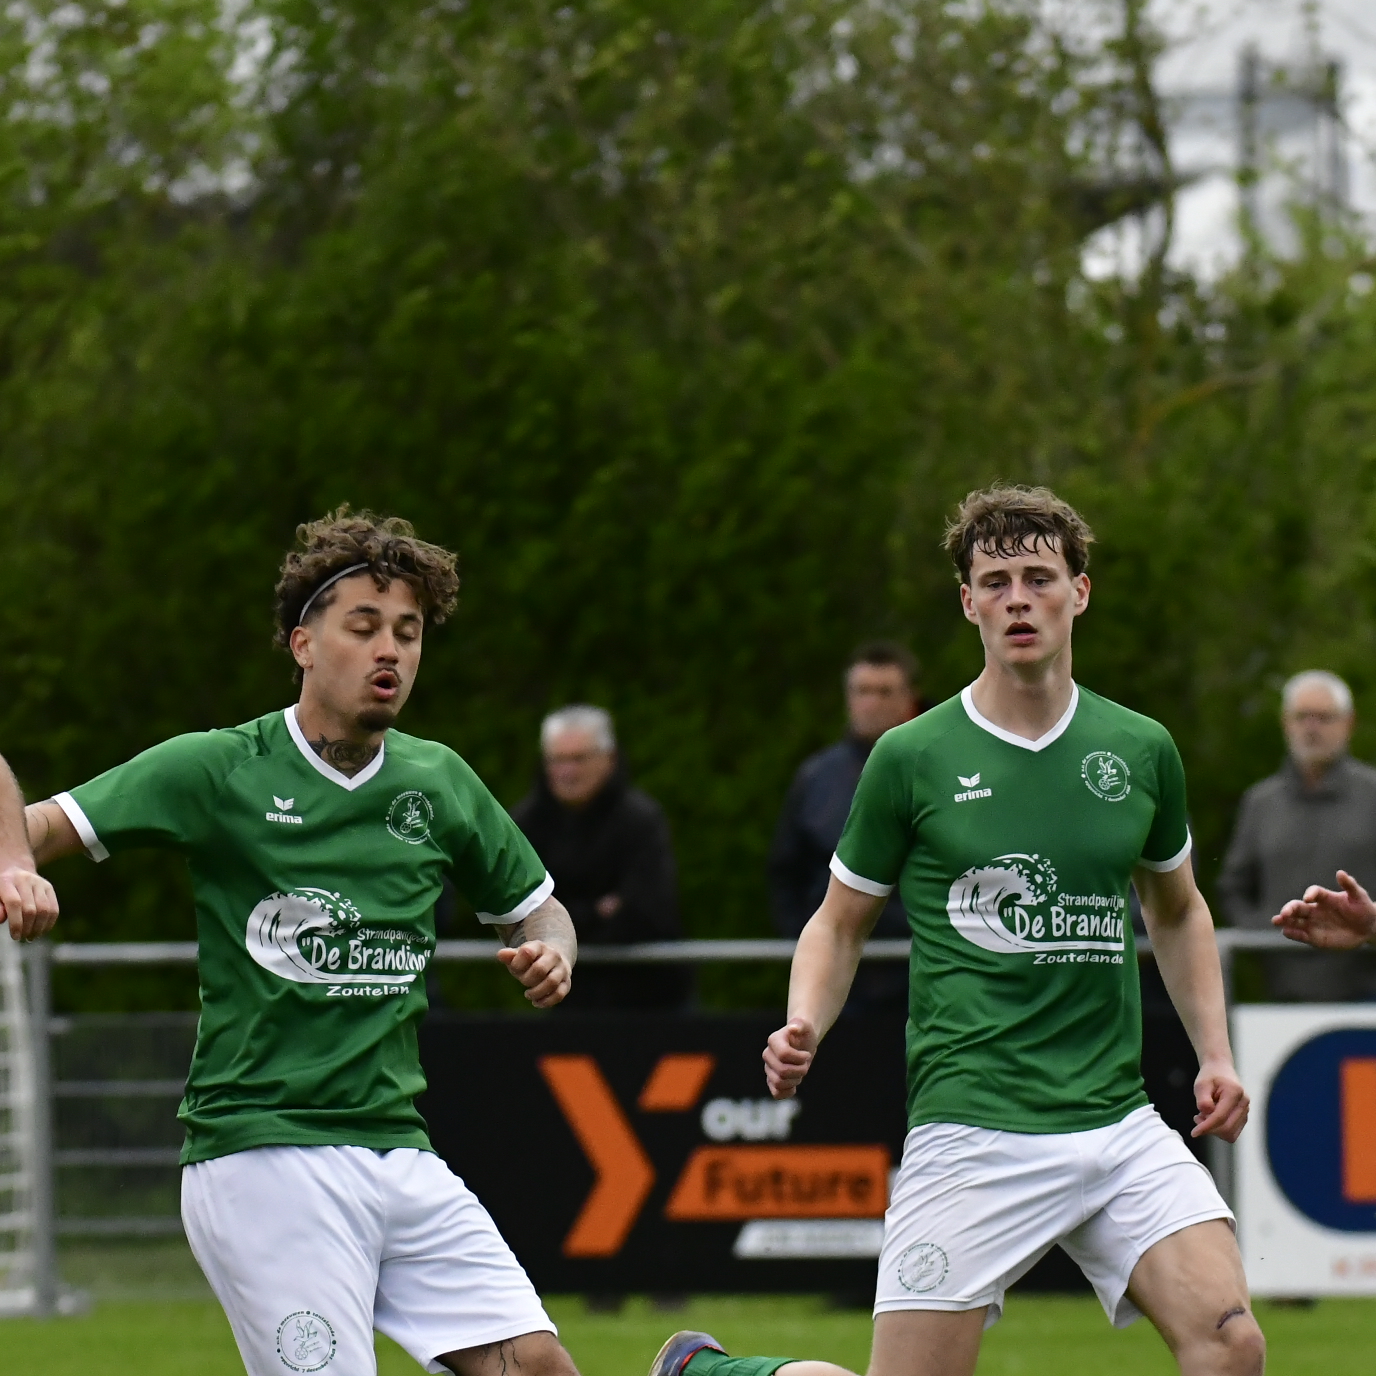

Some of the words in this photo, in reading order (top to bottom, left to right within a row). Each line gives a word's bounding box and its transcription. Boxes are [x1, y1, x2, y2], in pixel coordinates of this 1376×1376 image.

[954, 788, 992, 803] erima
[265, 811, 303, 824] erima
[1050, 905, 1124, 938] Brandin
[702, 1158, 874, 1205] Future
